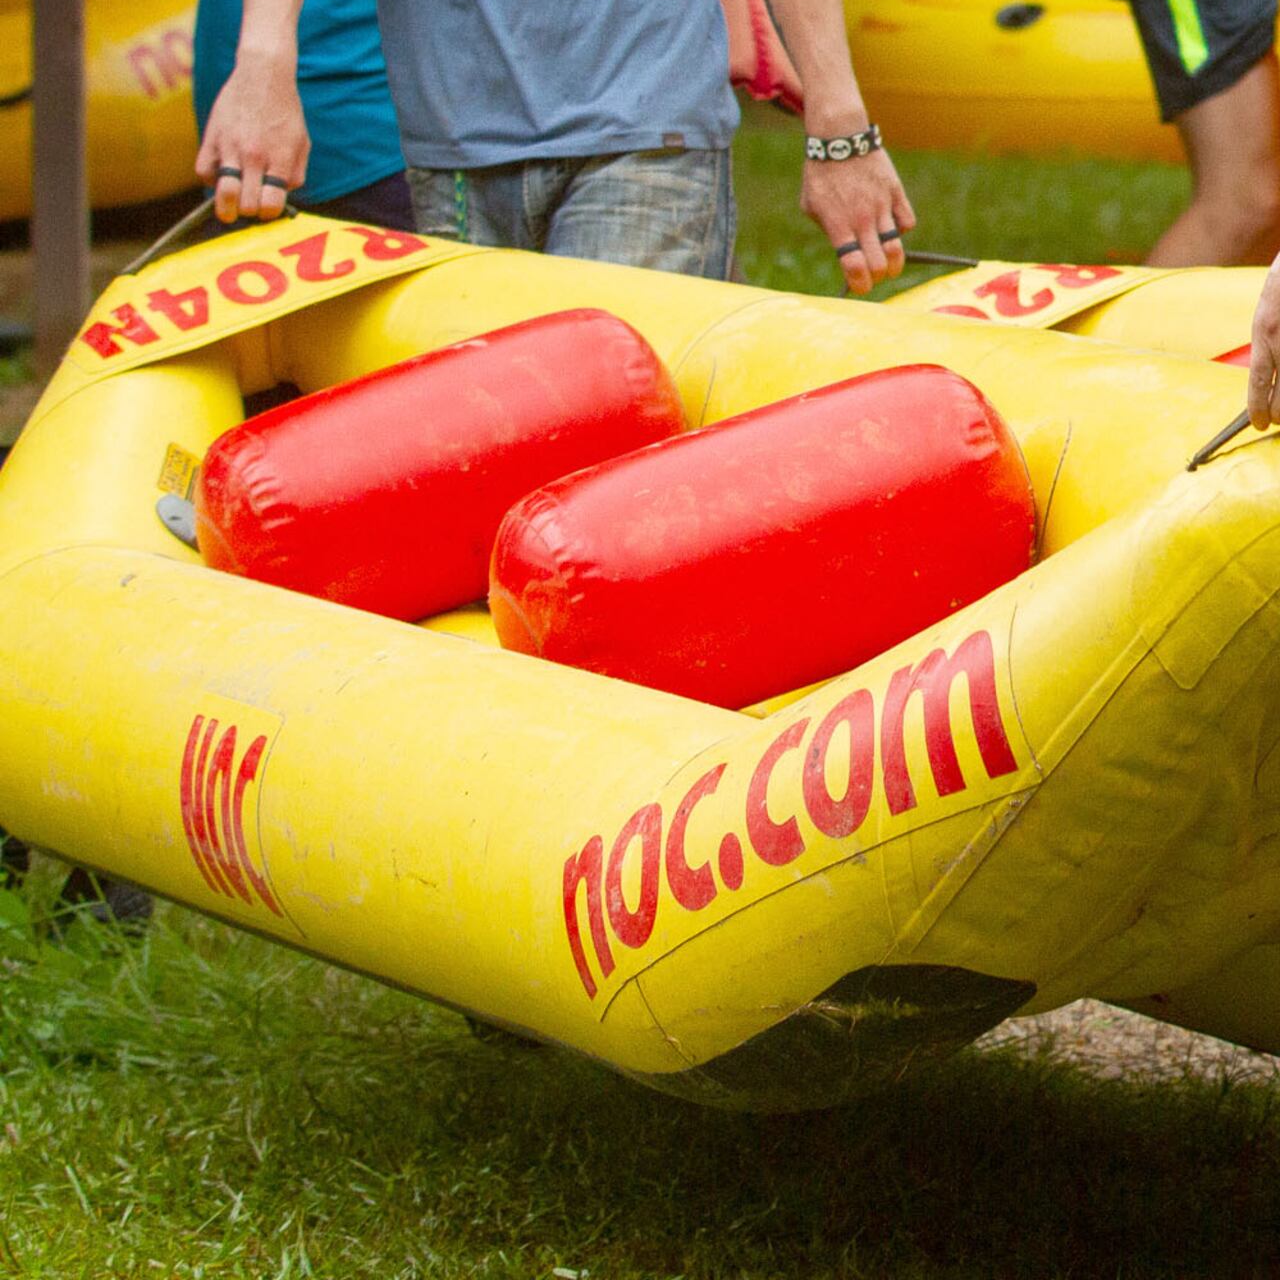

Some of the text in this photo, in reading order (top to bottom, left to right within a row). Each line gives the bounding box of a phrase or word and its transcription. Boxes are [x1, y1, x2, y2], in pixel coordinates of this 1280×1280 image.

[127, 31, 194, 97] no
[932, 263, 1123, 318] R2
[563, 630, 1019, 1001] noc.com
